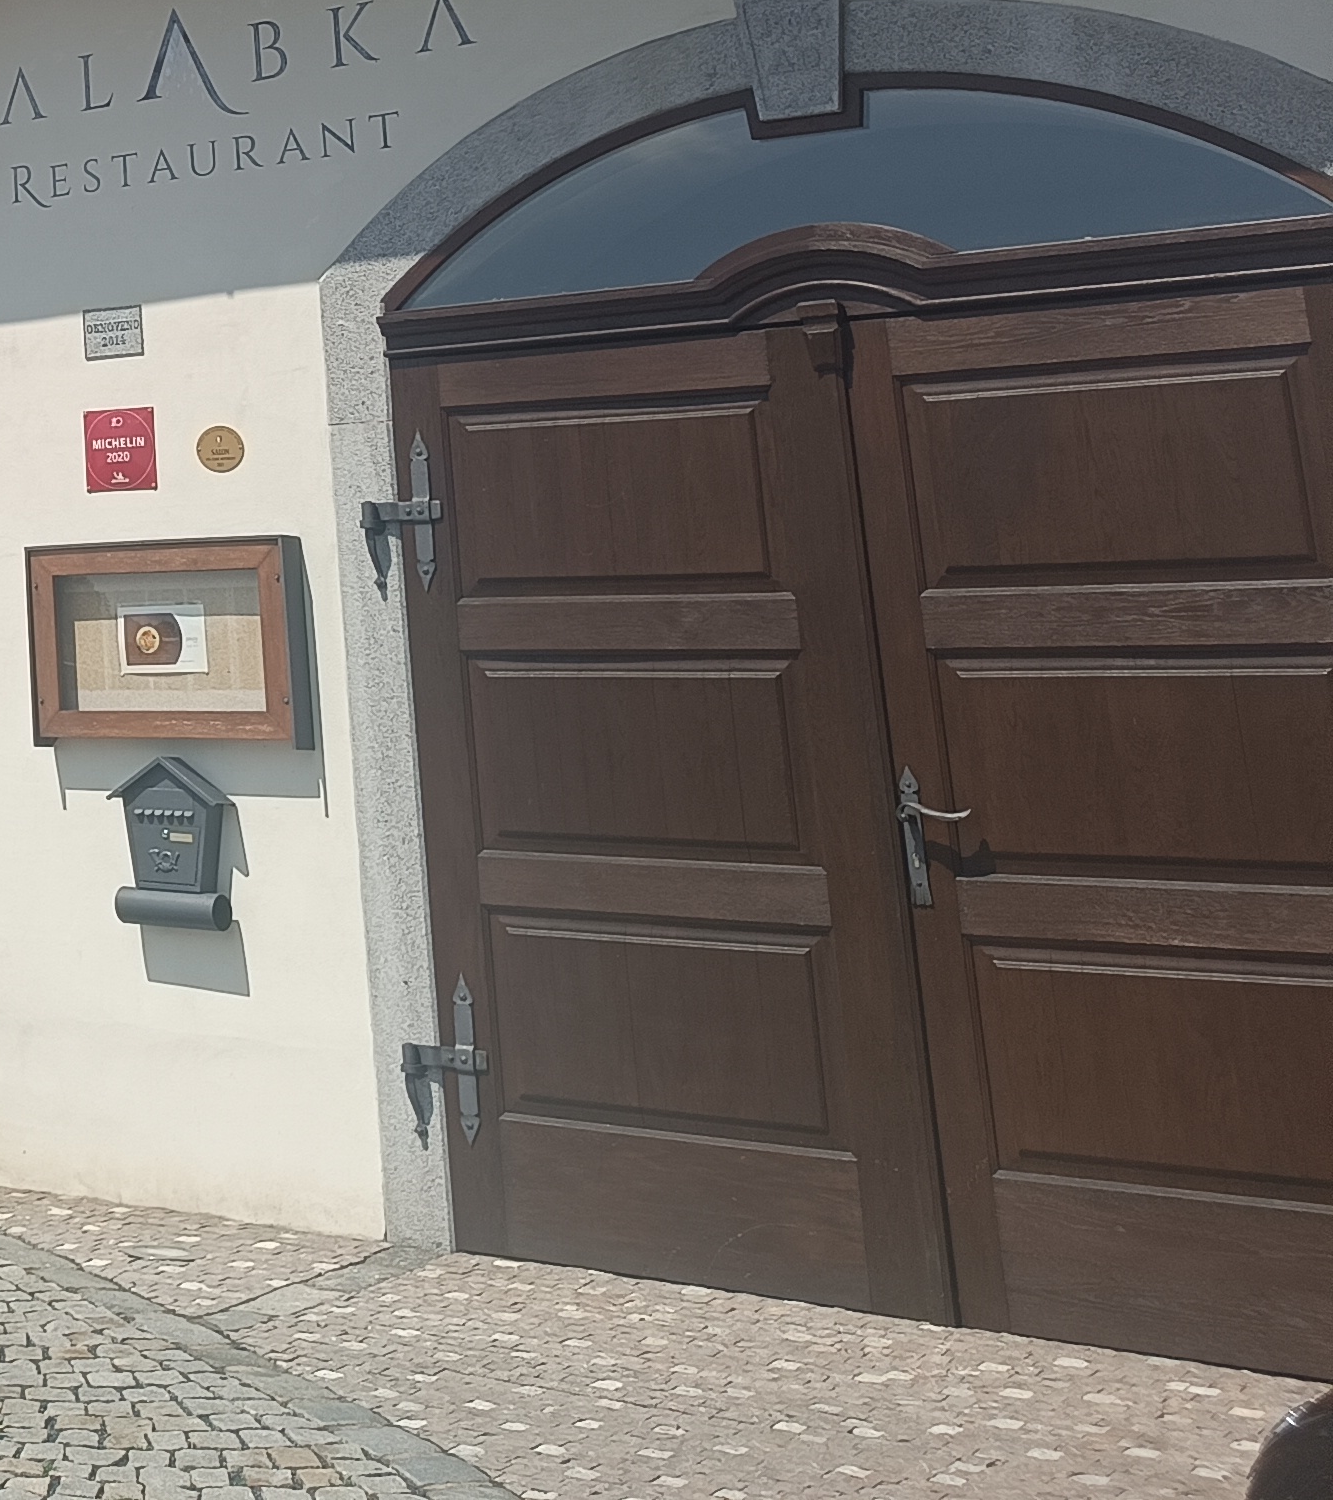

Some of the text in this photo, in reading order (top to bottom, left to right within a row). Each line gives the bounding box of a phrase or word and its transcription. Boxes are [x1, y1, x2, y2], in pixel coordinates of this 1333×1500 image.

[10, 110, 401, 209] RESTAURANT
[92, 436, 145, 450] MICHELIN
[106, 451, 130, 463] 2020
